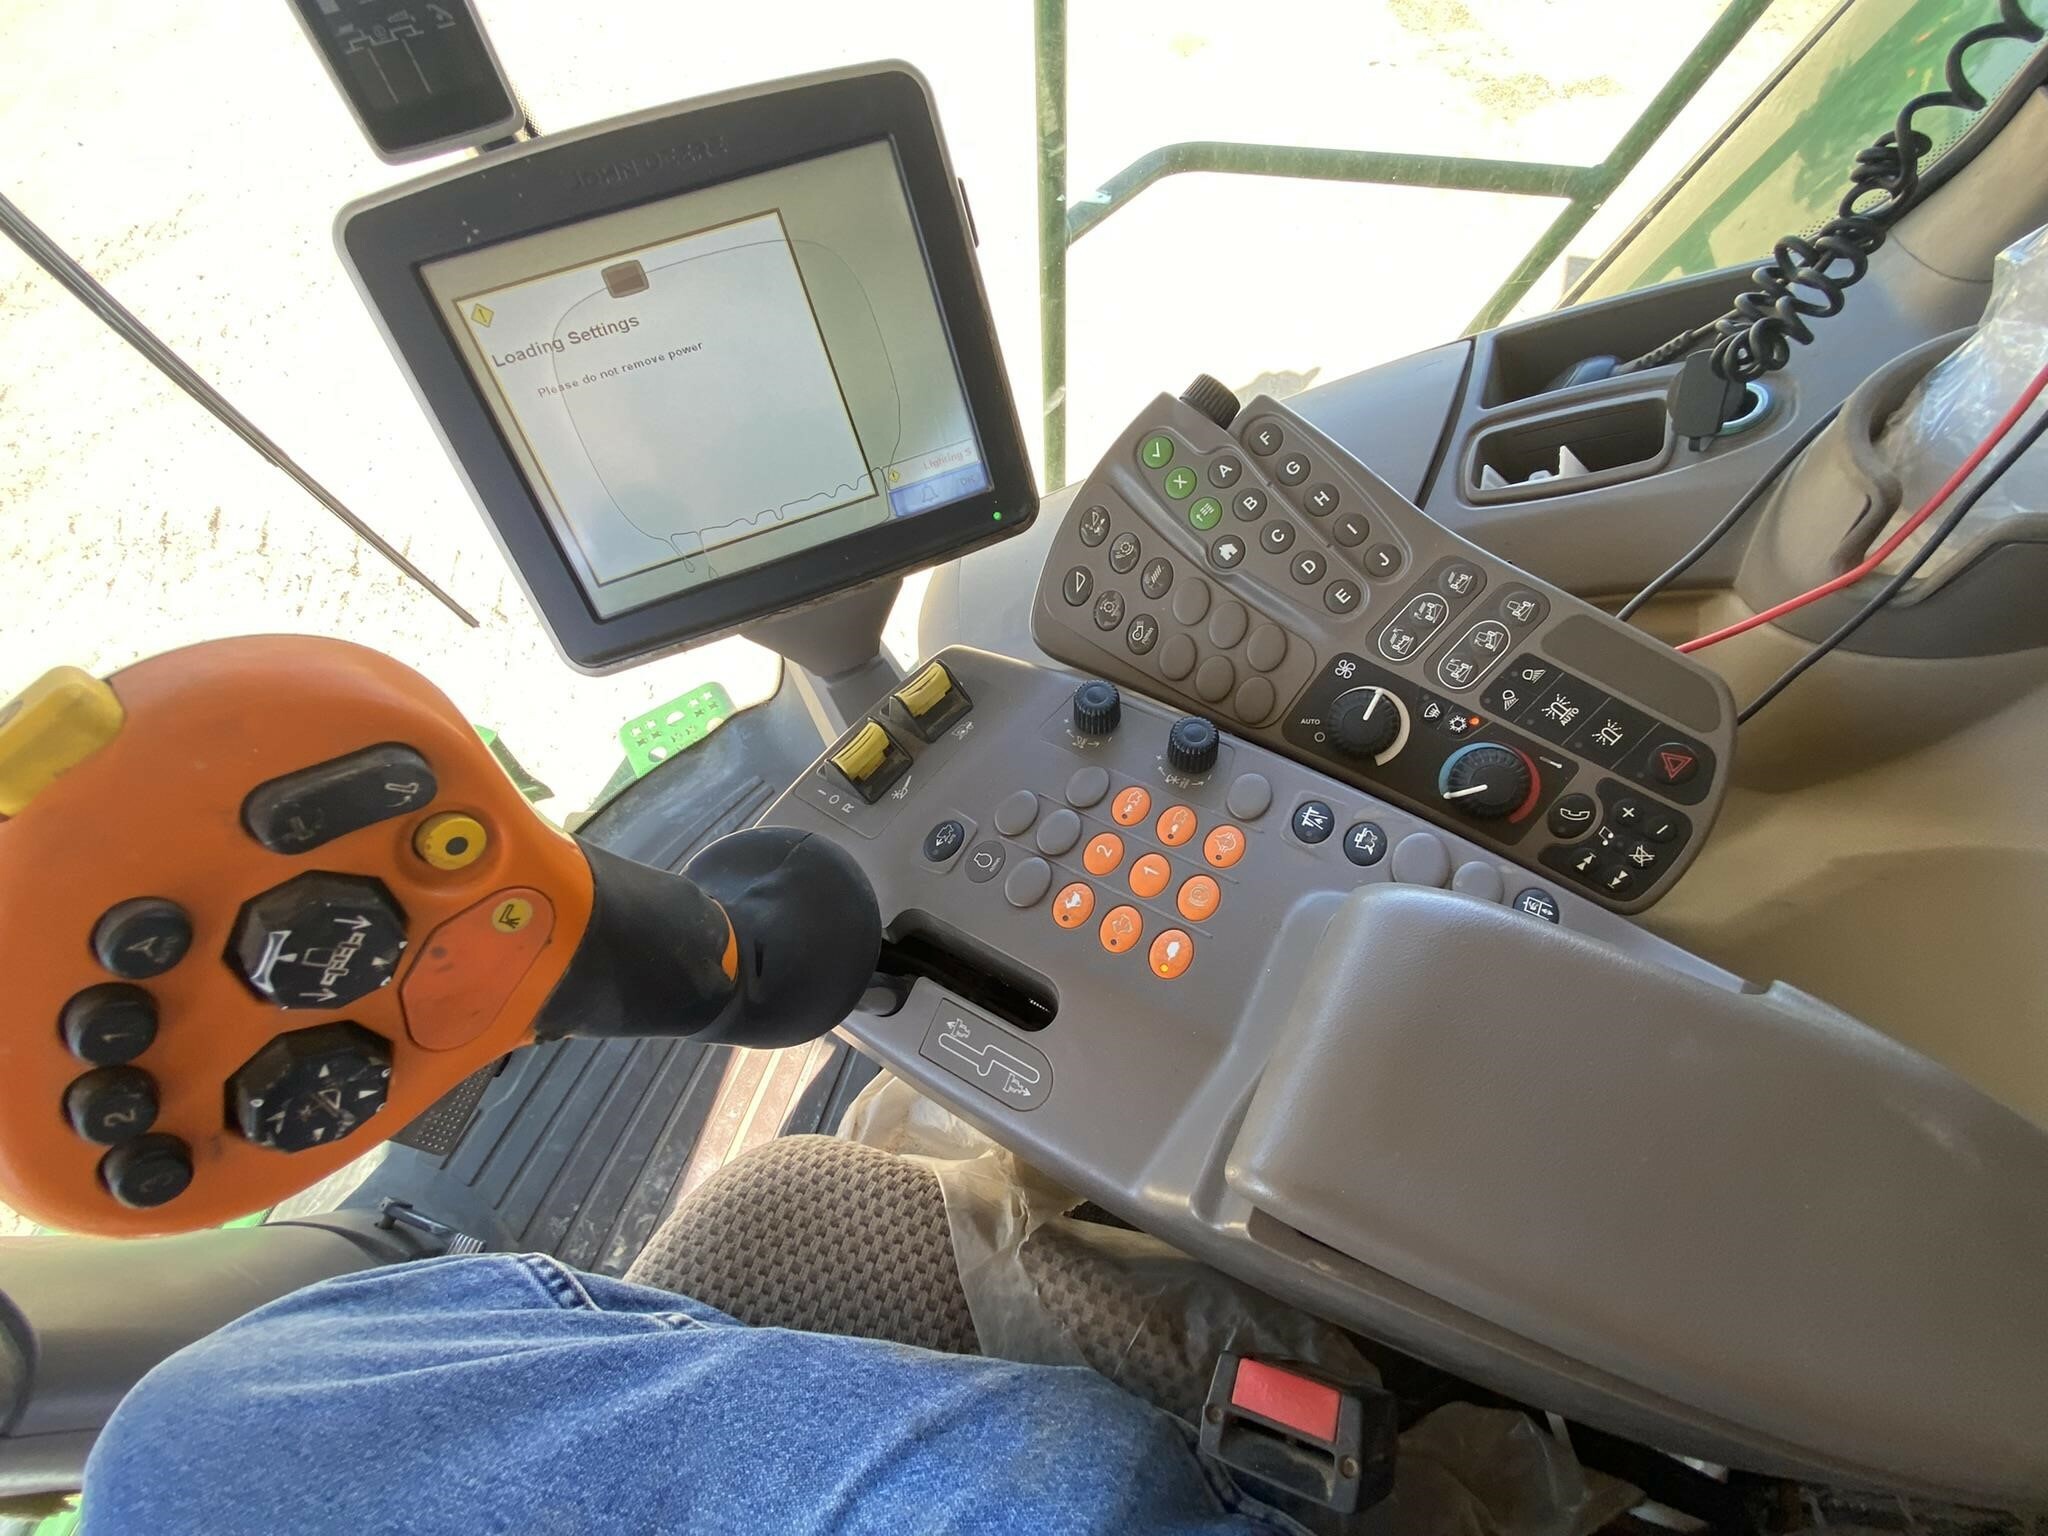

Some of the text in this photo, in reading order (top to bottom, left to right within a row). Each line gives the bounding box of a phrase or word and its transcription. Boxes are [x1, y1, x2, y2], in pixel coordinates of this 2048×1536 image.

[491, 316, 640, 367] Loading Settings
[537, 341, 703, 398] Please do not remove power
[1259, 431, 1270, 446] F
[1219, 464, 1233, 478] A
[1286, 460, 1301, 475] G
[1242, 496, 1258, 511] B
[1313, 490, 1330, 507] H
[1271, 529, 1285, 542] C
[1301, 559, 1316, 574] D
[1379, 552, 1390, 566] J
[1335, 588, 1351, 604] E
[1300, 718, 1321, 726] AUTO
[1560, 707, 1580, 726] AUTO
[841, 802, 855, 814] R
[1096, 844, 1113, 858] 2
[1143, 865, 1160, 876] 1
[103, 1108, 135, 1128] 2
